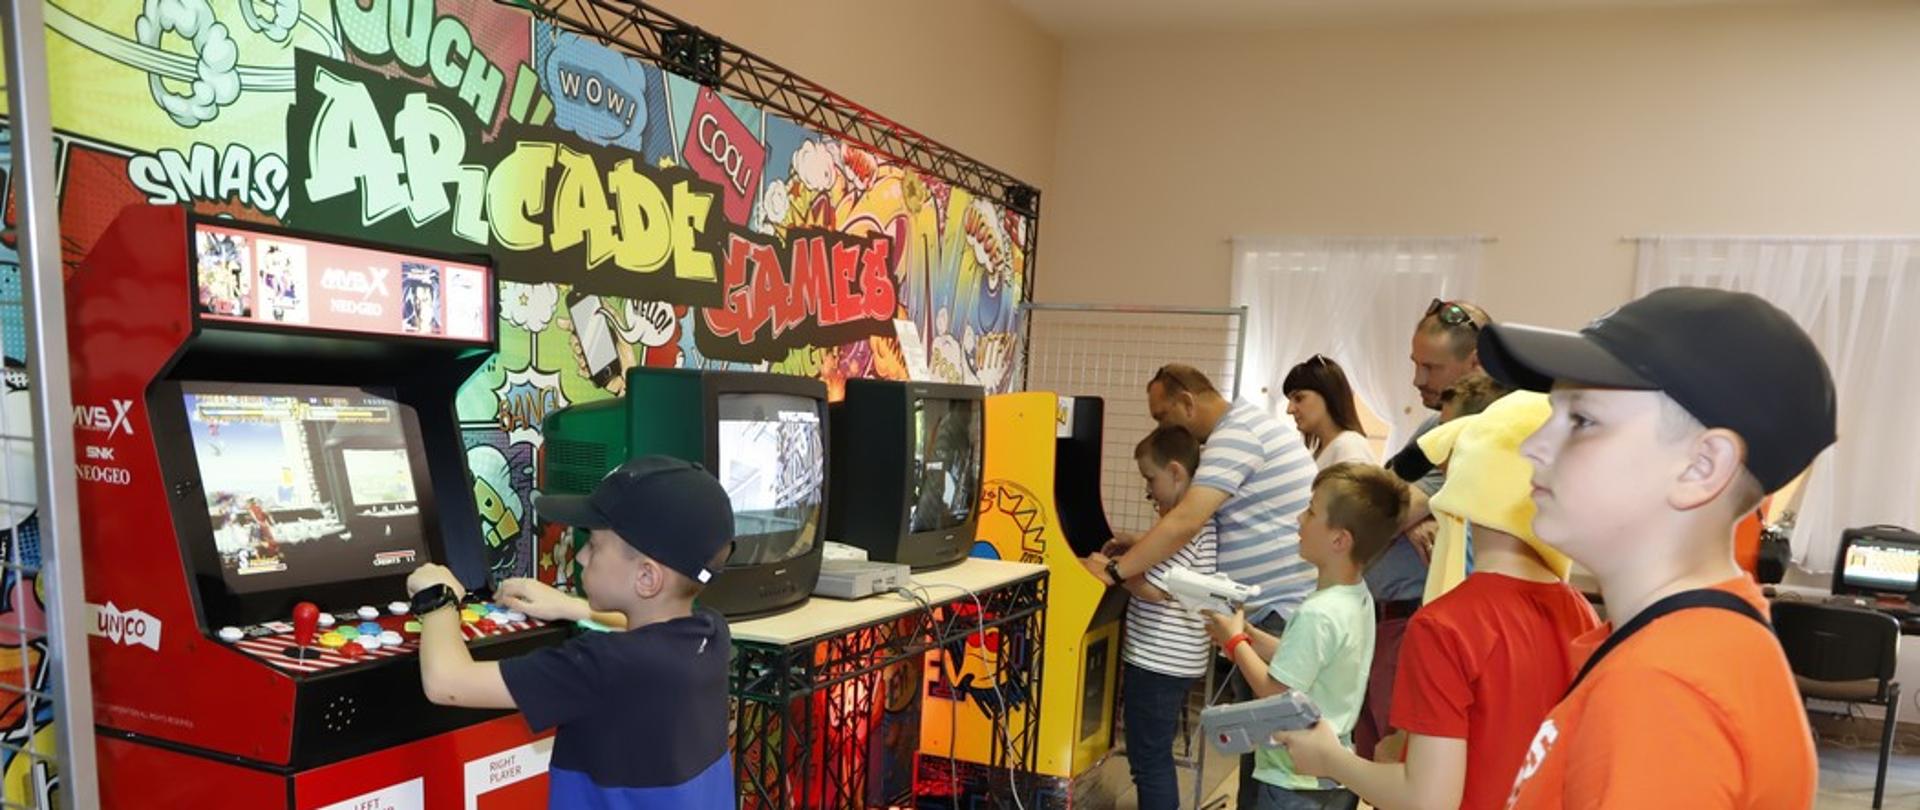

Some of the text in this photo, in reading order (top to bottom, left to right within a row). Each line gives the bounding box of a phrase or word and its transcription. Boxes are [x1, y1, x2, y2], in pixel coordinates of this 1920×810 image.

[559, 70, 637, 126] WOW!
[128, 143, 289, 220] SMAS
[304, 66, 718, 282] ARCADE
[699, 113, 752, 195] COOL!
[702, 232, 896, 345] GAMES
[86, 445, 115, 460] SNK
[489, 755, 516, 772] RIGHT
[489, 764, 522, 784] PLAYER
